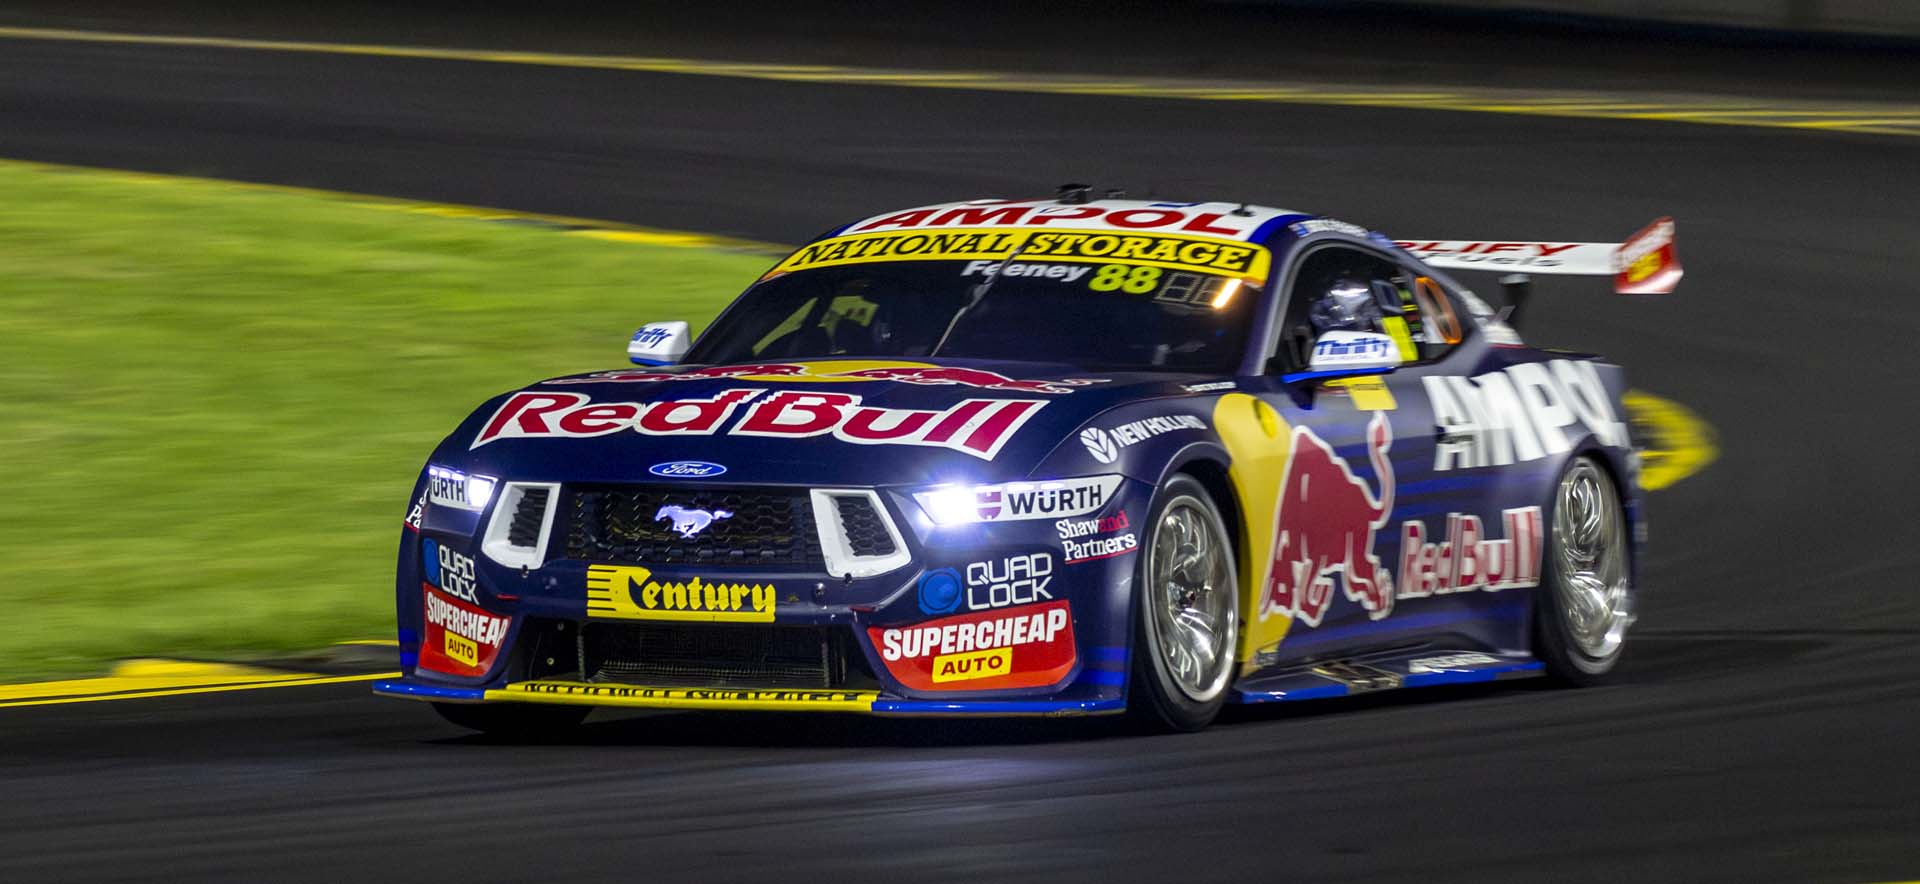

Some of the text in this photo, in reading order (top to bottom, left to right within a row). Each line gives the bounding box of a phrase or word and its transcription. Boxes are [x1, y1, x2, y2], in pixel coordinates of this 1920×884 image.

[853, 206, 1241, 235] AMPOL
[789, 233, 1250, 270] NATIONAL STORAGE
[960, 260, 1163, 294] Feeney 88
[1109, 415, 1208, 448] NEW HOLLAND
[661, 463, 713, 476] Ford
[1008, 484, 1102, 515] WÜRTH
[439, 544, 476, 581] QUAD
[1061, 533, 1138, 561] Partners
[440, 567, 480, 605] LOCK
[966, 552, 1053, 586] QUAD
[587, 564, 777, 622] Century
[967, 576, 1054, 610] LOCK
[427, 591, 509, 649] SUPERCHEAP
[883, 608, 1068, 662] SUPERCHEAP
[448, 638, 474, 660] AUTO
[940, 655, 1004, 676] AUTO
